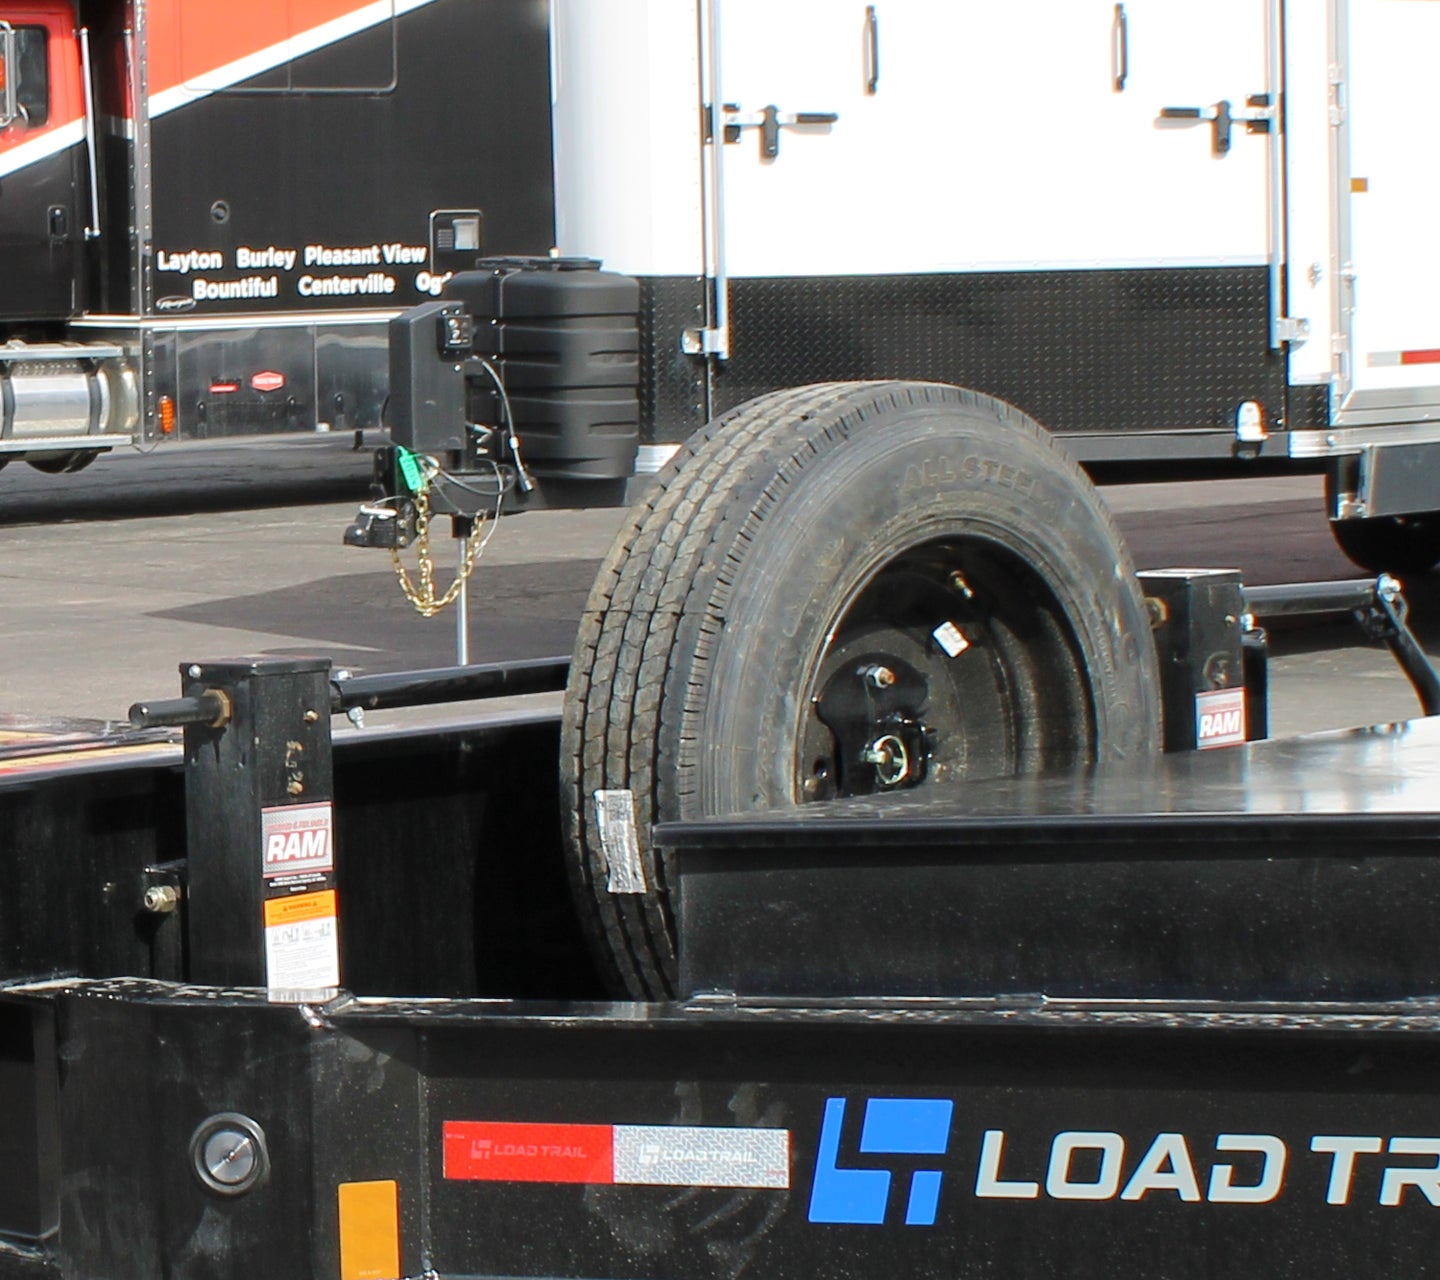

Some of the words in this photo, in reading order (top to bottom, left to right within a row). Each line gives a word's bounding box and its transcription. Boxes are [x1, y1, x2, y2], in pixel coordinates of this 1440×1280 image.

[157, 248, 223, 274] Layton
[236, 246, 296, 273] Burley
[304, 245, 380, 267] Pleasant
[381, 243, 427, 265] View
[193, 275, 278, 299] Bountiful
[297, 273, 395, 297] Centerville
[416, 271, 453, 296] Og
[1199, 710, 1241, 739] RAM
[267, 830, 326, 861] RAM
[494, 1144, 537, 1157] LOAD
[541, 1145, 587, 1158] TRAIL
[661, 1149, 709, 1163] LOAD
[976, 1130, 1284, 1205] LOAD
